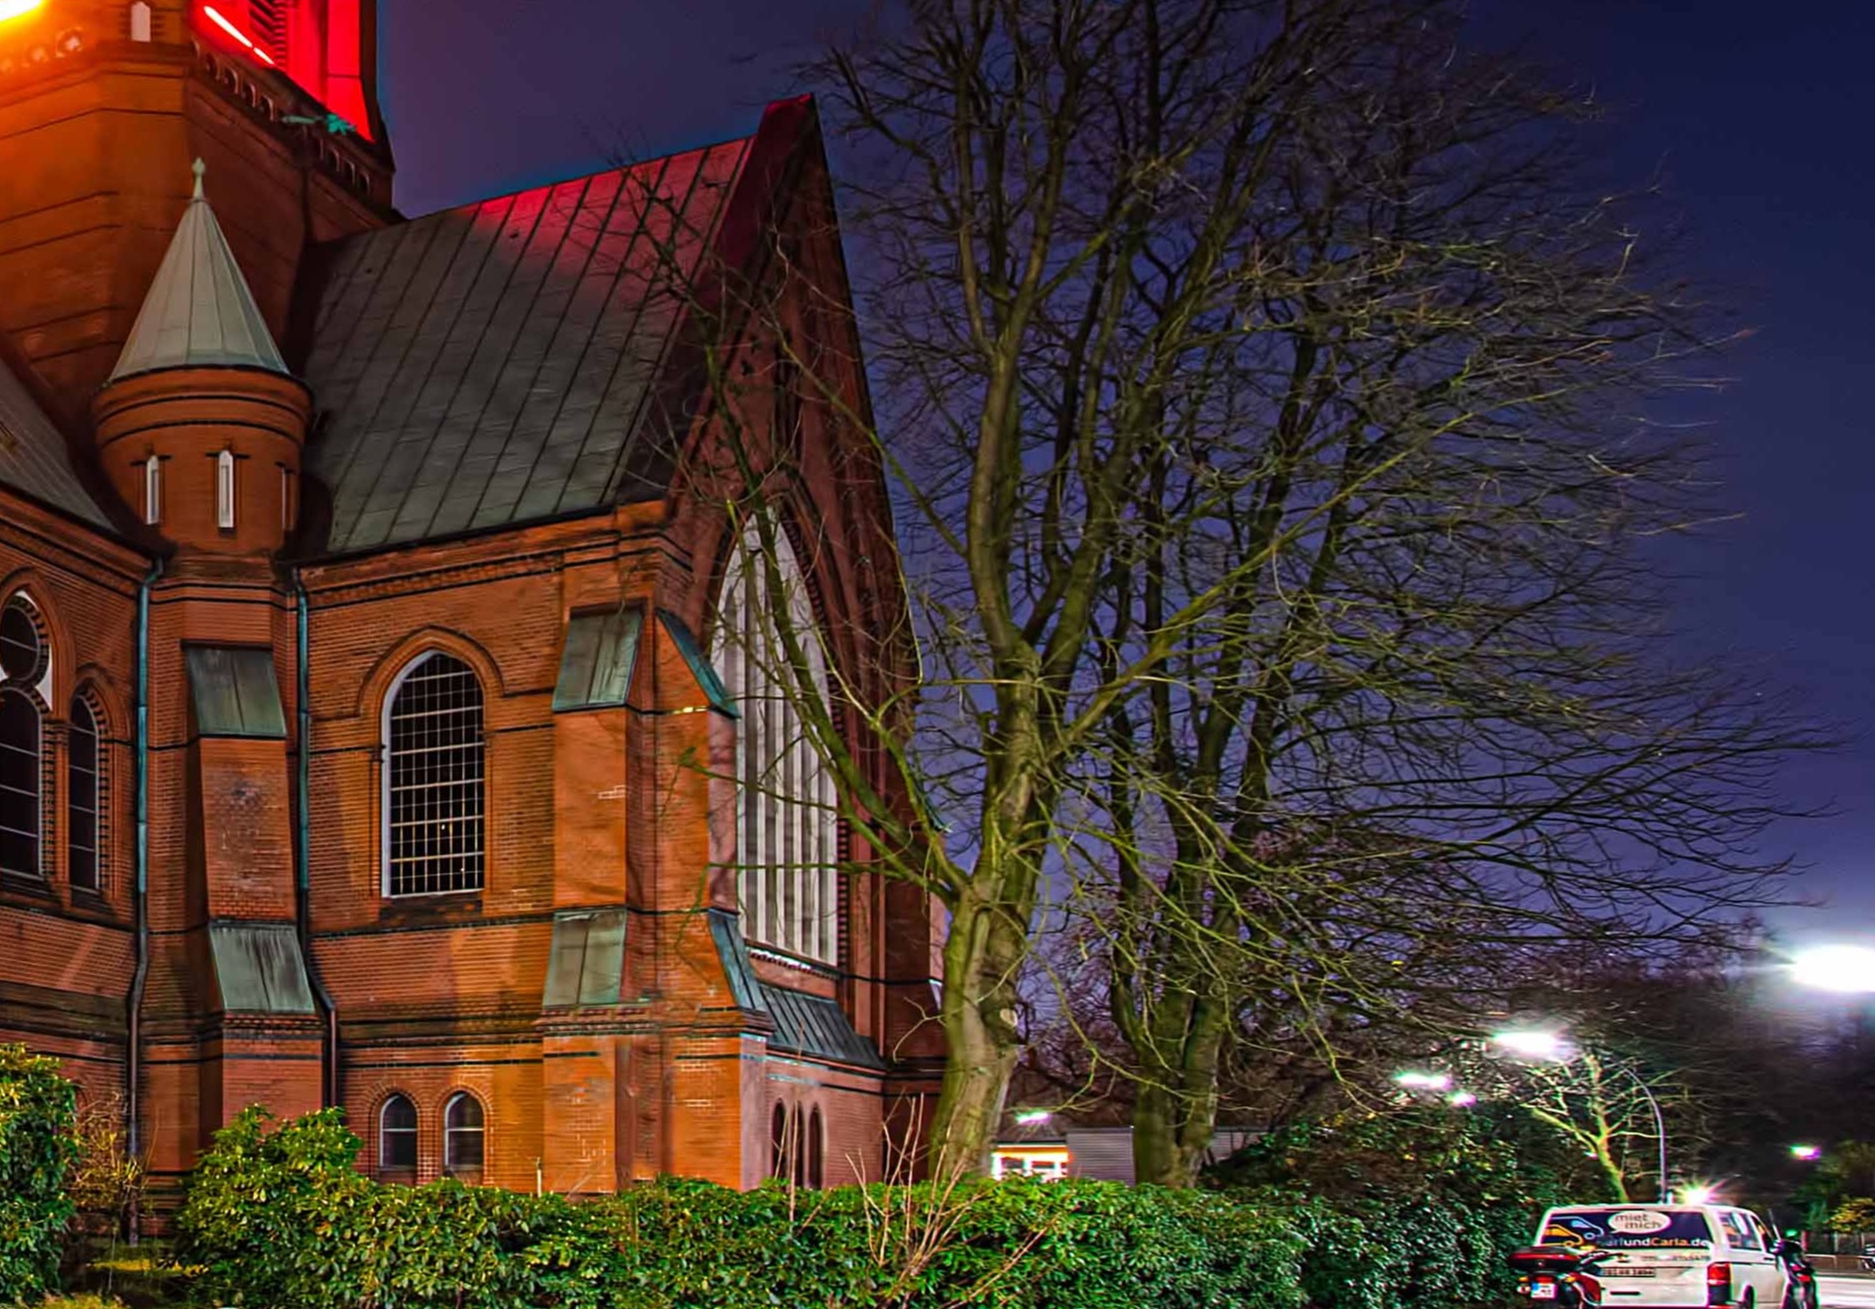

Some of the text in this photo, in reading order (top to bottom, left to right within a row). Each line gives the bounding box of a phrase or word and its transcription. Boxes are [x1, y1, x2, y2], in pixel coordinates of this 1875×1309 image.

[1615, 1213, 1648, 1222] miet
[1625, 1221, 1662, 1230] mich
[1598, 1237, 1710, 1247] arlundCarla.de
